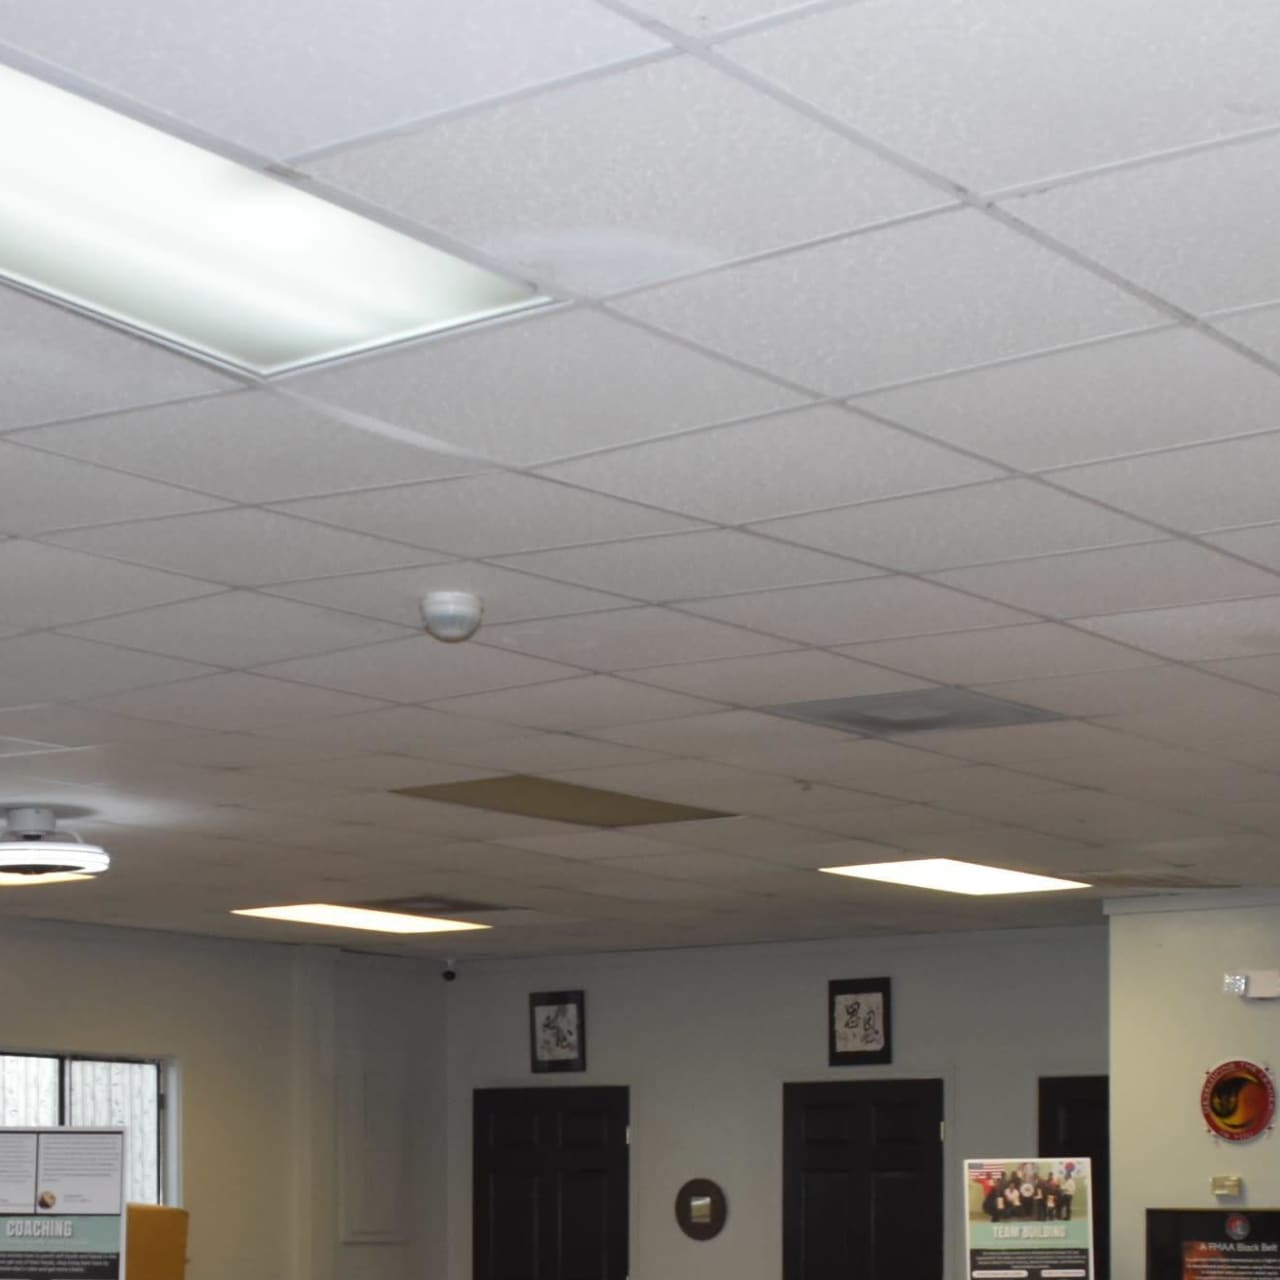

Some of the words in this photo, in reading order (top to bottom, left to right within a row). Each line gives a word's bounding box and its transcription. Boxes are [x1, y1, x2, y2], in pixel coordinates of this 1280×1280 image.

[5, 1219, 73, 1238] COACHING
[992, 1225, 1020, 1239] TEAM
[1021, 1225, 1067, 1239] BUILDING
